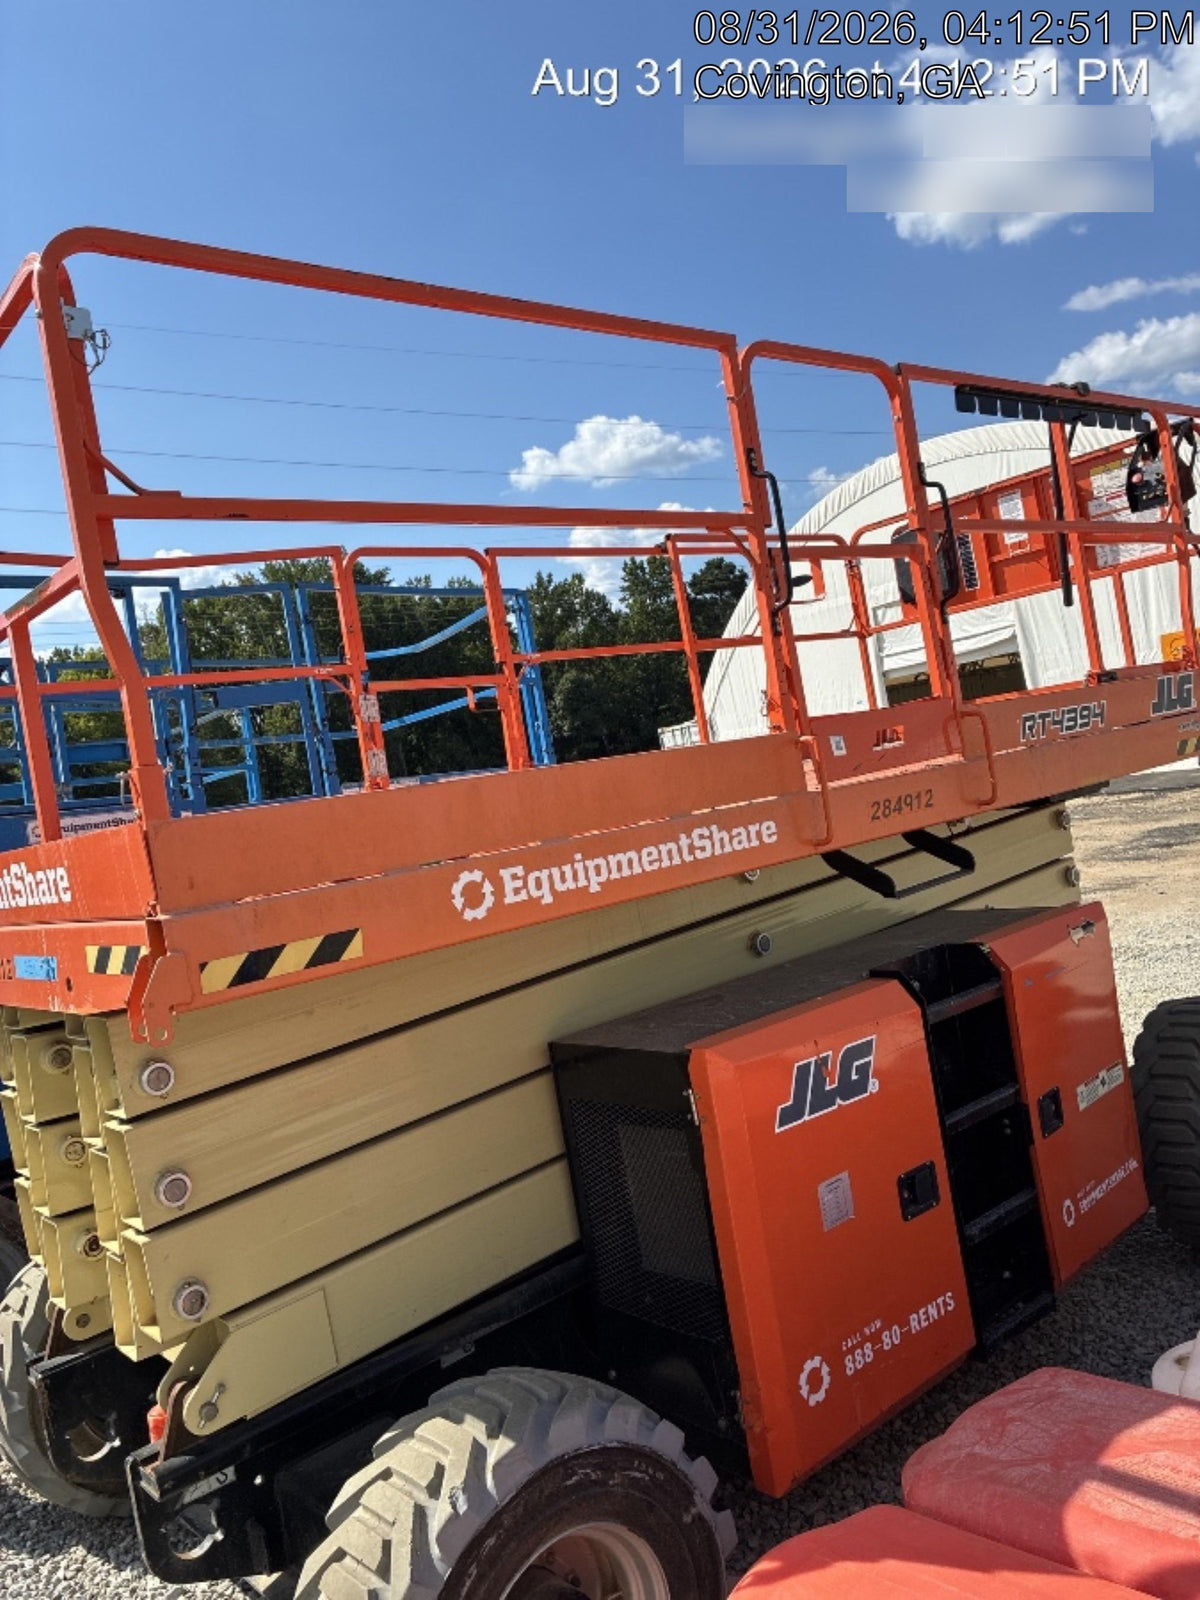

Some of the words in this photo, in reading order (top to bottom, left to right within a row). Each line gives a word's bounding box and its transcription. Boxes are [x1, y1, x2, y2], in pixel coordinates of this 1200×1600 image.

[1020, 700, 1107, 742] RT4394
[1150, 671, 1197, 717] JLG
[870, 789, 934, 822] 284912
[500, 820, 778, 905] EquipmentShare
[775, 1034, 879, 1134] JLG
[844, 1291, 956, 1376] 888-80-RENTS
